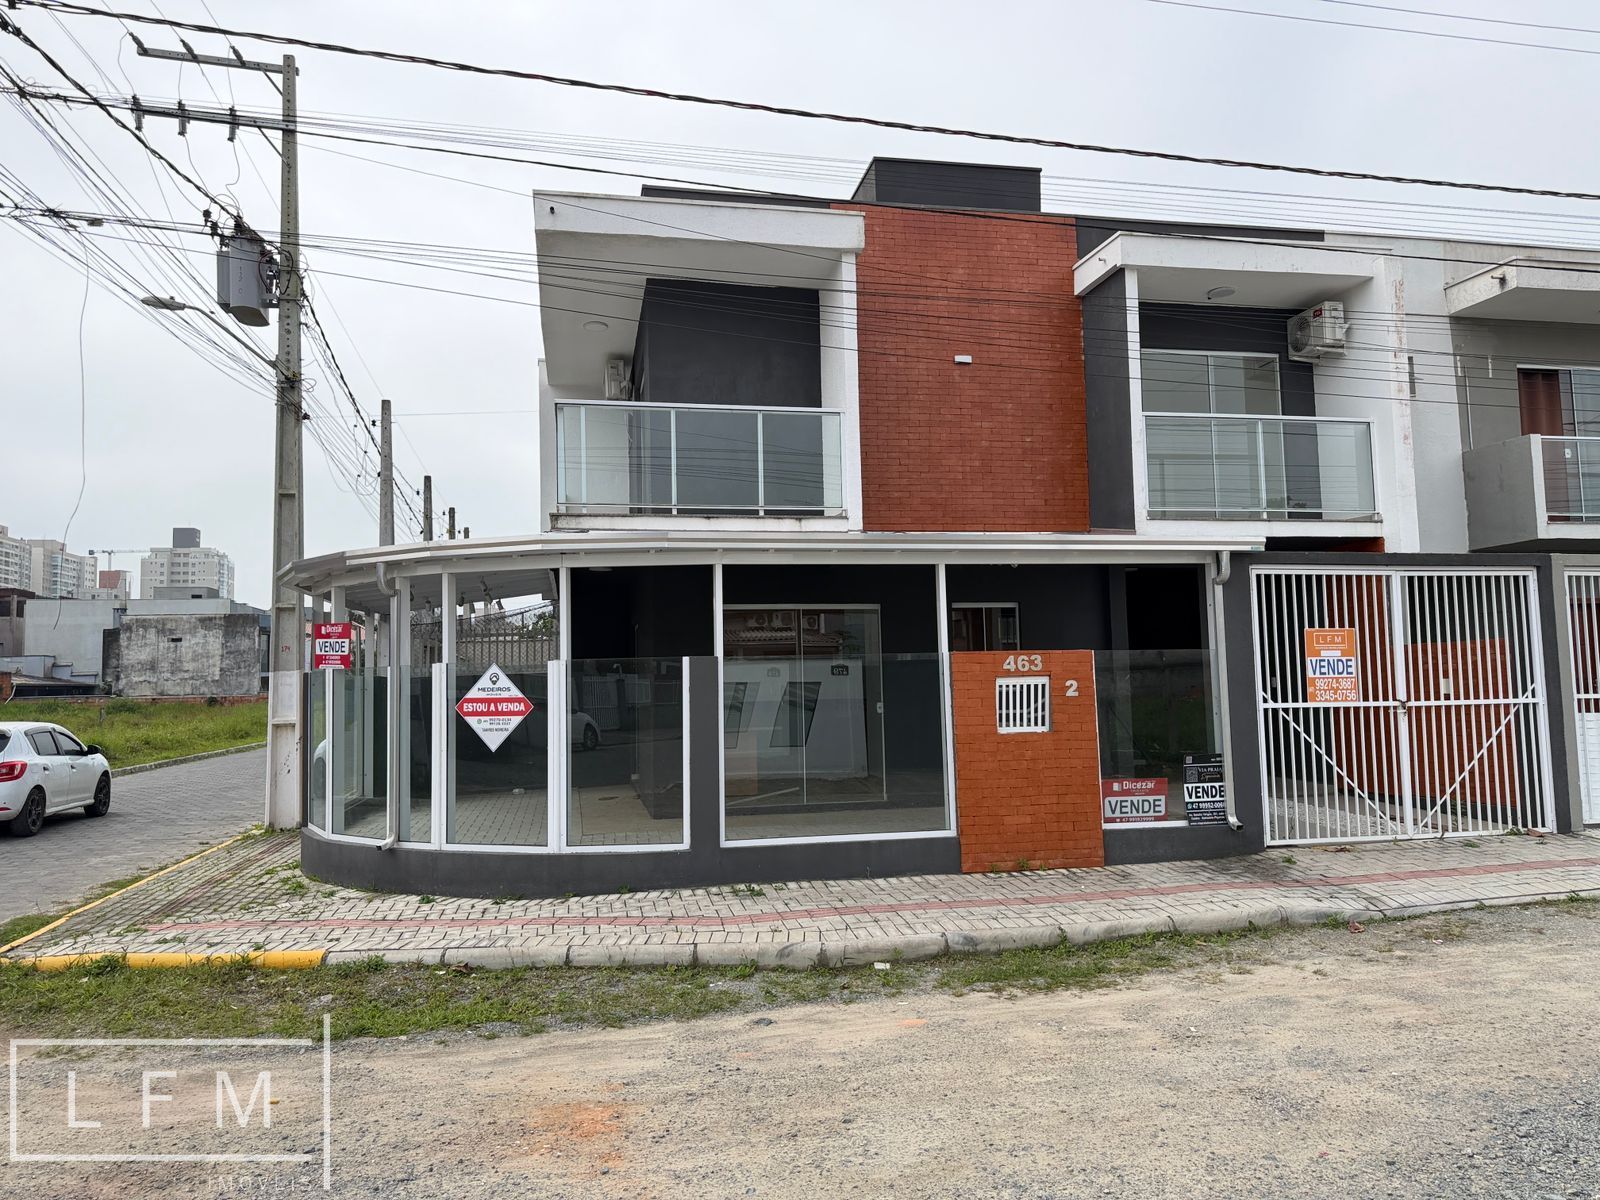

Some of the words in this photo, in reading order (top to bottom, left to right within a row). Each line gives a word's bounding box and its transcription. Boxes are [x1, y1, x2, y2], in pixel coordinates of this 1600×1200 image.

[318, 641, 346, 653] VENDE
[1002, 654, 1043, 672] 463
[1309, 658, 1354, 676] VENDE
[1064, 679, 1079, 697] 2
[1314, 678, 1356, 690] 99274-3687
[1315, 689, 1357, 701] 3345-0756
[463, 702, 488, 712] ESTOU
[489, 702, 495, 711] A
[497, 702, 525, 712] VENDA
[1185, 784, 1225, 800] VENDE
[1108, 798, 1162, 815] VENDE
